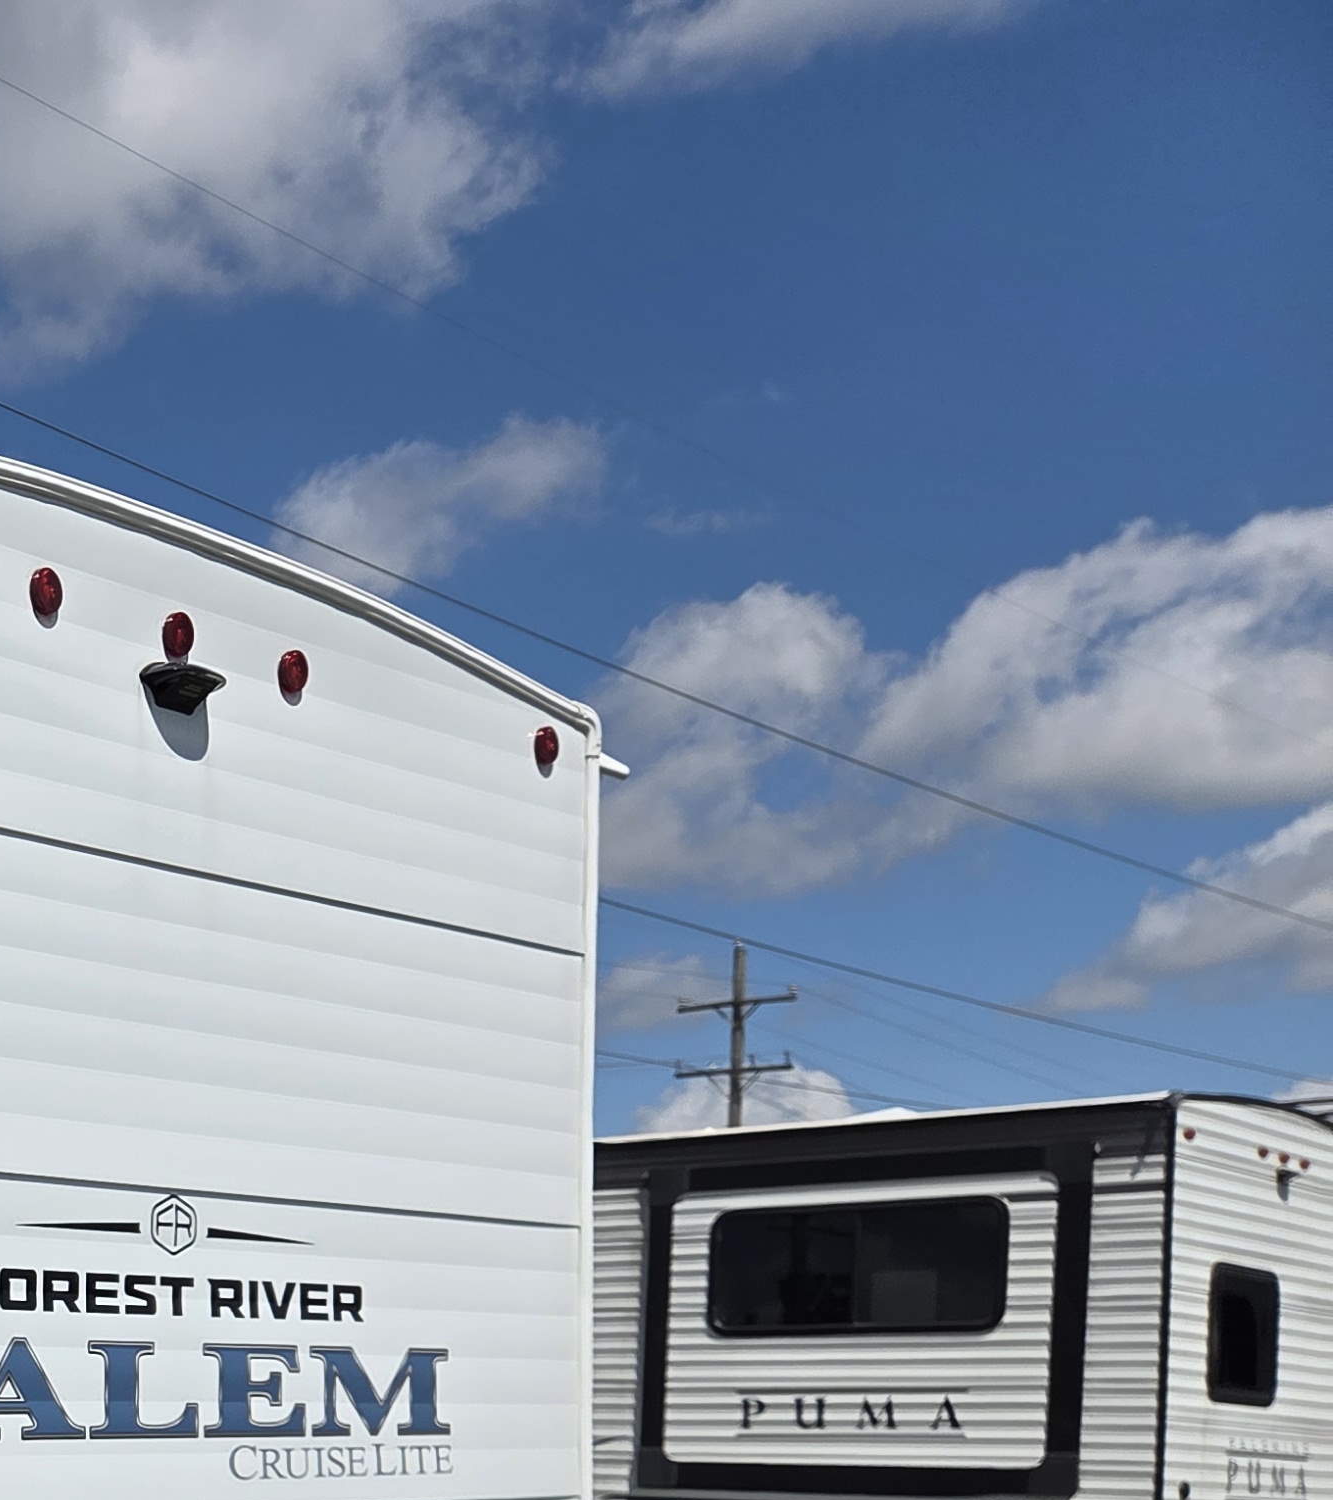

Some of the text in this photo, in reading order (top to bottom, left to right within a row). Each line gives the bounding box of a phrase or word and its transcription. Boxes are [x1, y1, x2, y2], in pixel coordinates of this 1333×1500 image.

[207, 1278, 364, 1323] RIVER
[740, 1393, 962, 1430] PUMA
[1225, 1457, 1307, 1496] PUMA
